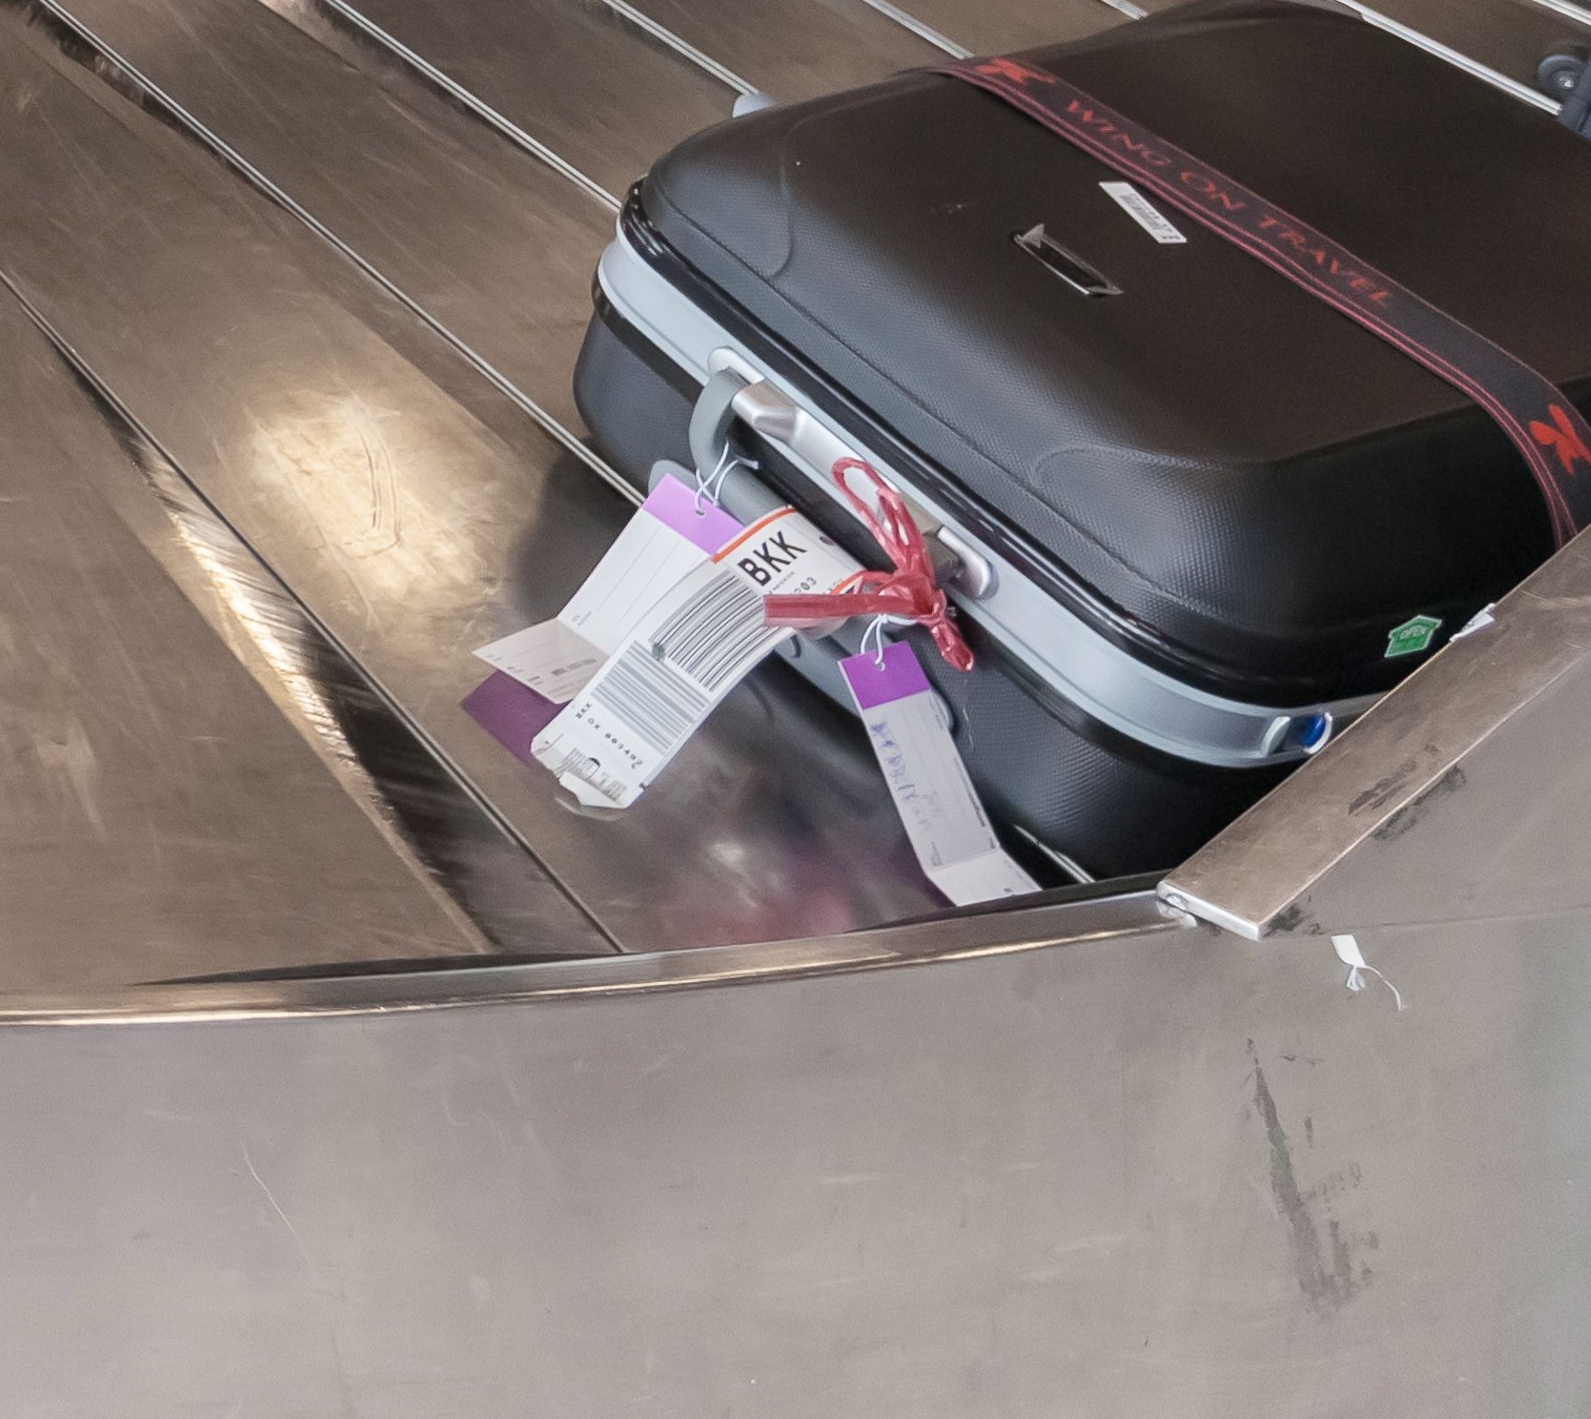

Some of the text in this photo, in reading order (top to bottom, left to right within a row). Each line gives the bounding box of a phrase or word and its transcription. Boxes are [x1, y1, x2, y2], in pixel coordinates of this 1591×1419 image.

[1068, 98, 1172, 168] WING
[1180, 170, 1248, 212] ON
[1259, 215, 1394, 310] TRAVEL
[736, 530, 808, 587] BKK
